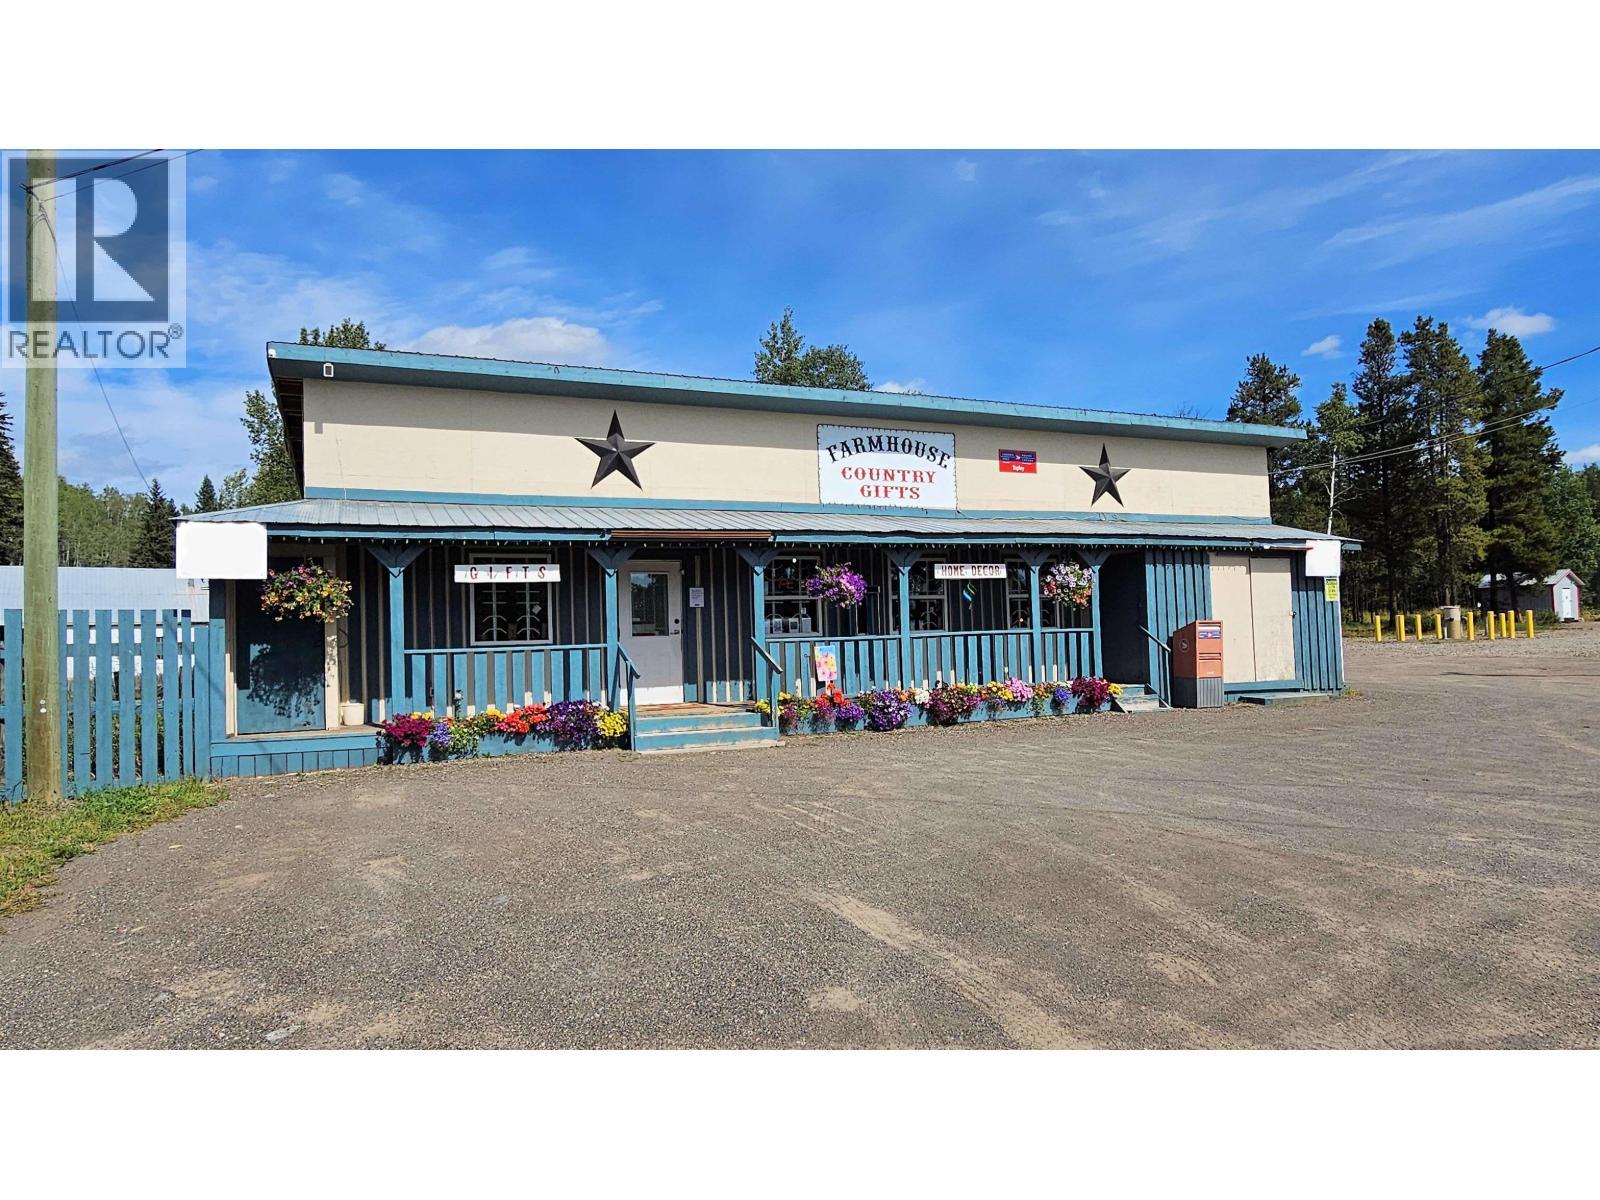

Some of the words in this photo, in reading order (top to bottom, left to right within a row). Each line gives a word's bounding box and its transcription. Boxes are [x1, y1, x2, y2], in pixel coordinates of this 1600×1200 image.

[826, 435, 951, 469] FARMHOUSE
[841, 467, 936, 484] COUNTRY
[860, 485, 920, 500] GIFTS
[470, 566, 546, 580] GIFTS
[941, 565, 965, 577] HOME
[971, 565, 1000, 577] DECOR
